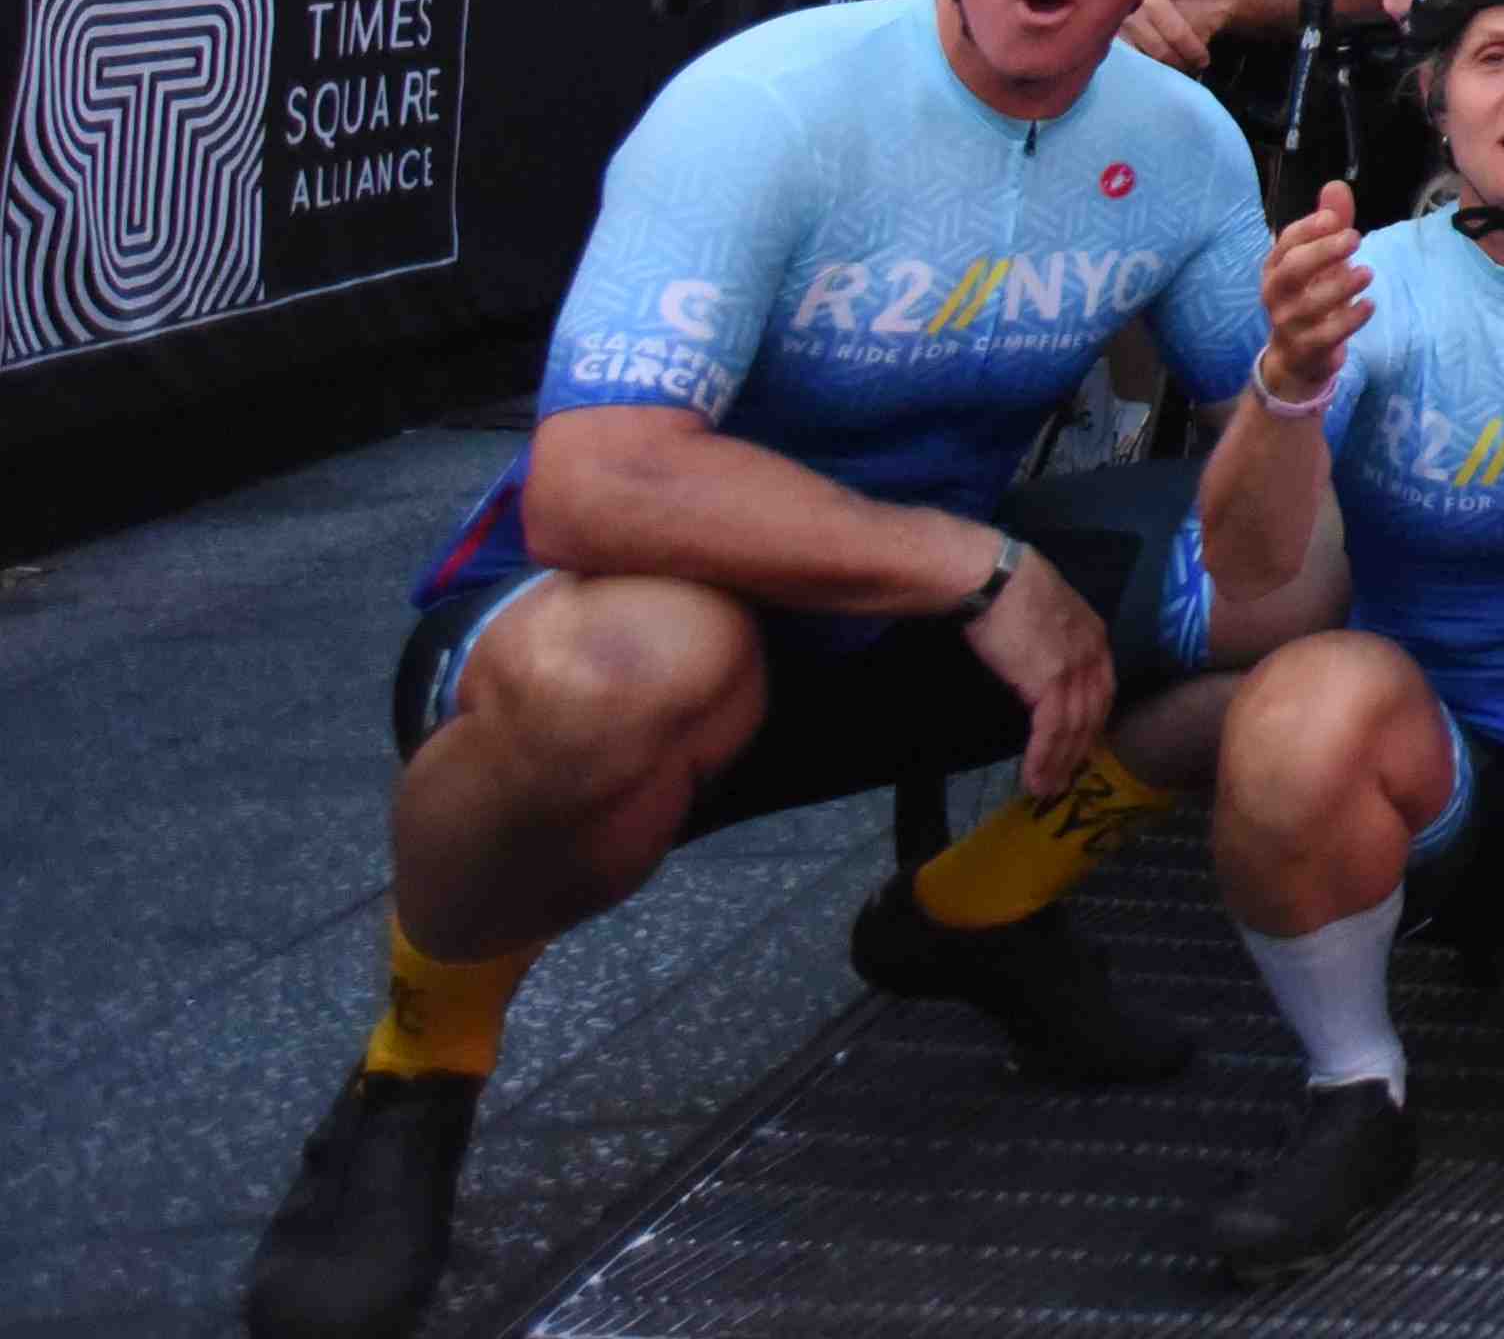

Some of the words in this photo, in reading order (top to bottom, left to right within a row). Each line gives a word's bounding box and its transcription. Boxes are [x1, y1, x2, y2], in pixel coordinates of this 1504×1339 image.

[286, 66, 441, 146] SQUARE
[290, 145, 434, 213] ALLIANCE
[790, 251, 1163, 337] R2//NYC
[836, 341, 900, 365] RIDE
[911, 339, 959, 363] FOR
[974, 330, 1092, 355] CAMPFIRE
[1443, 494, 1492, 513] FOR
